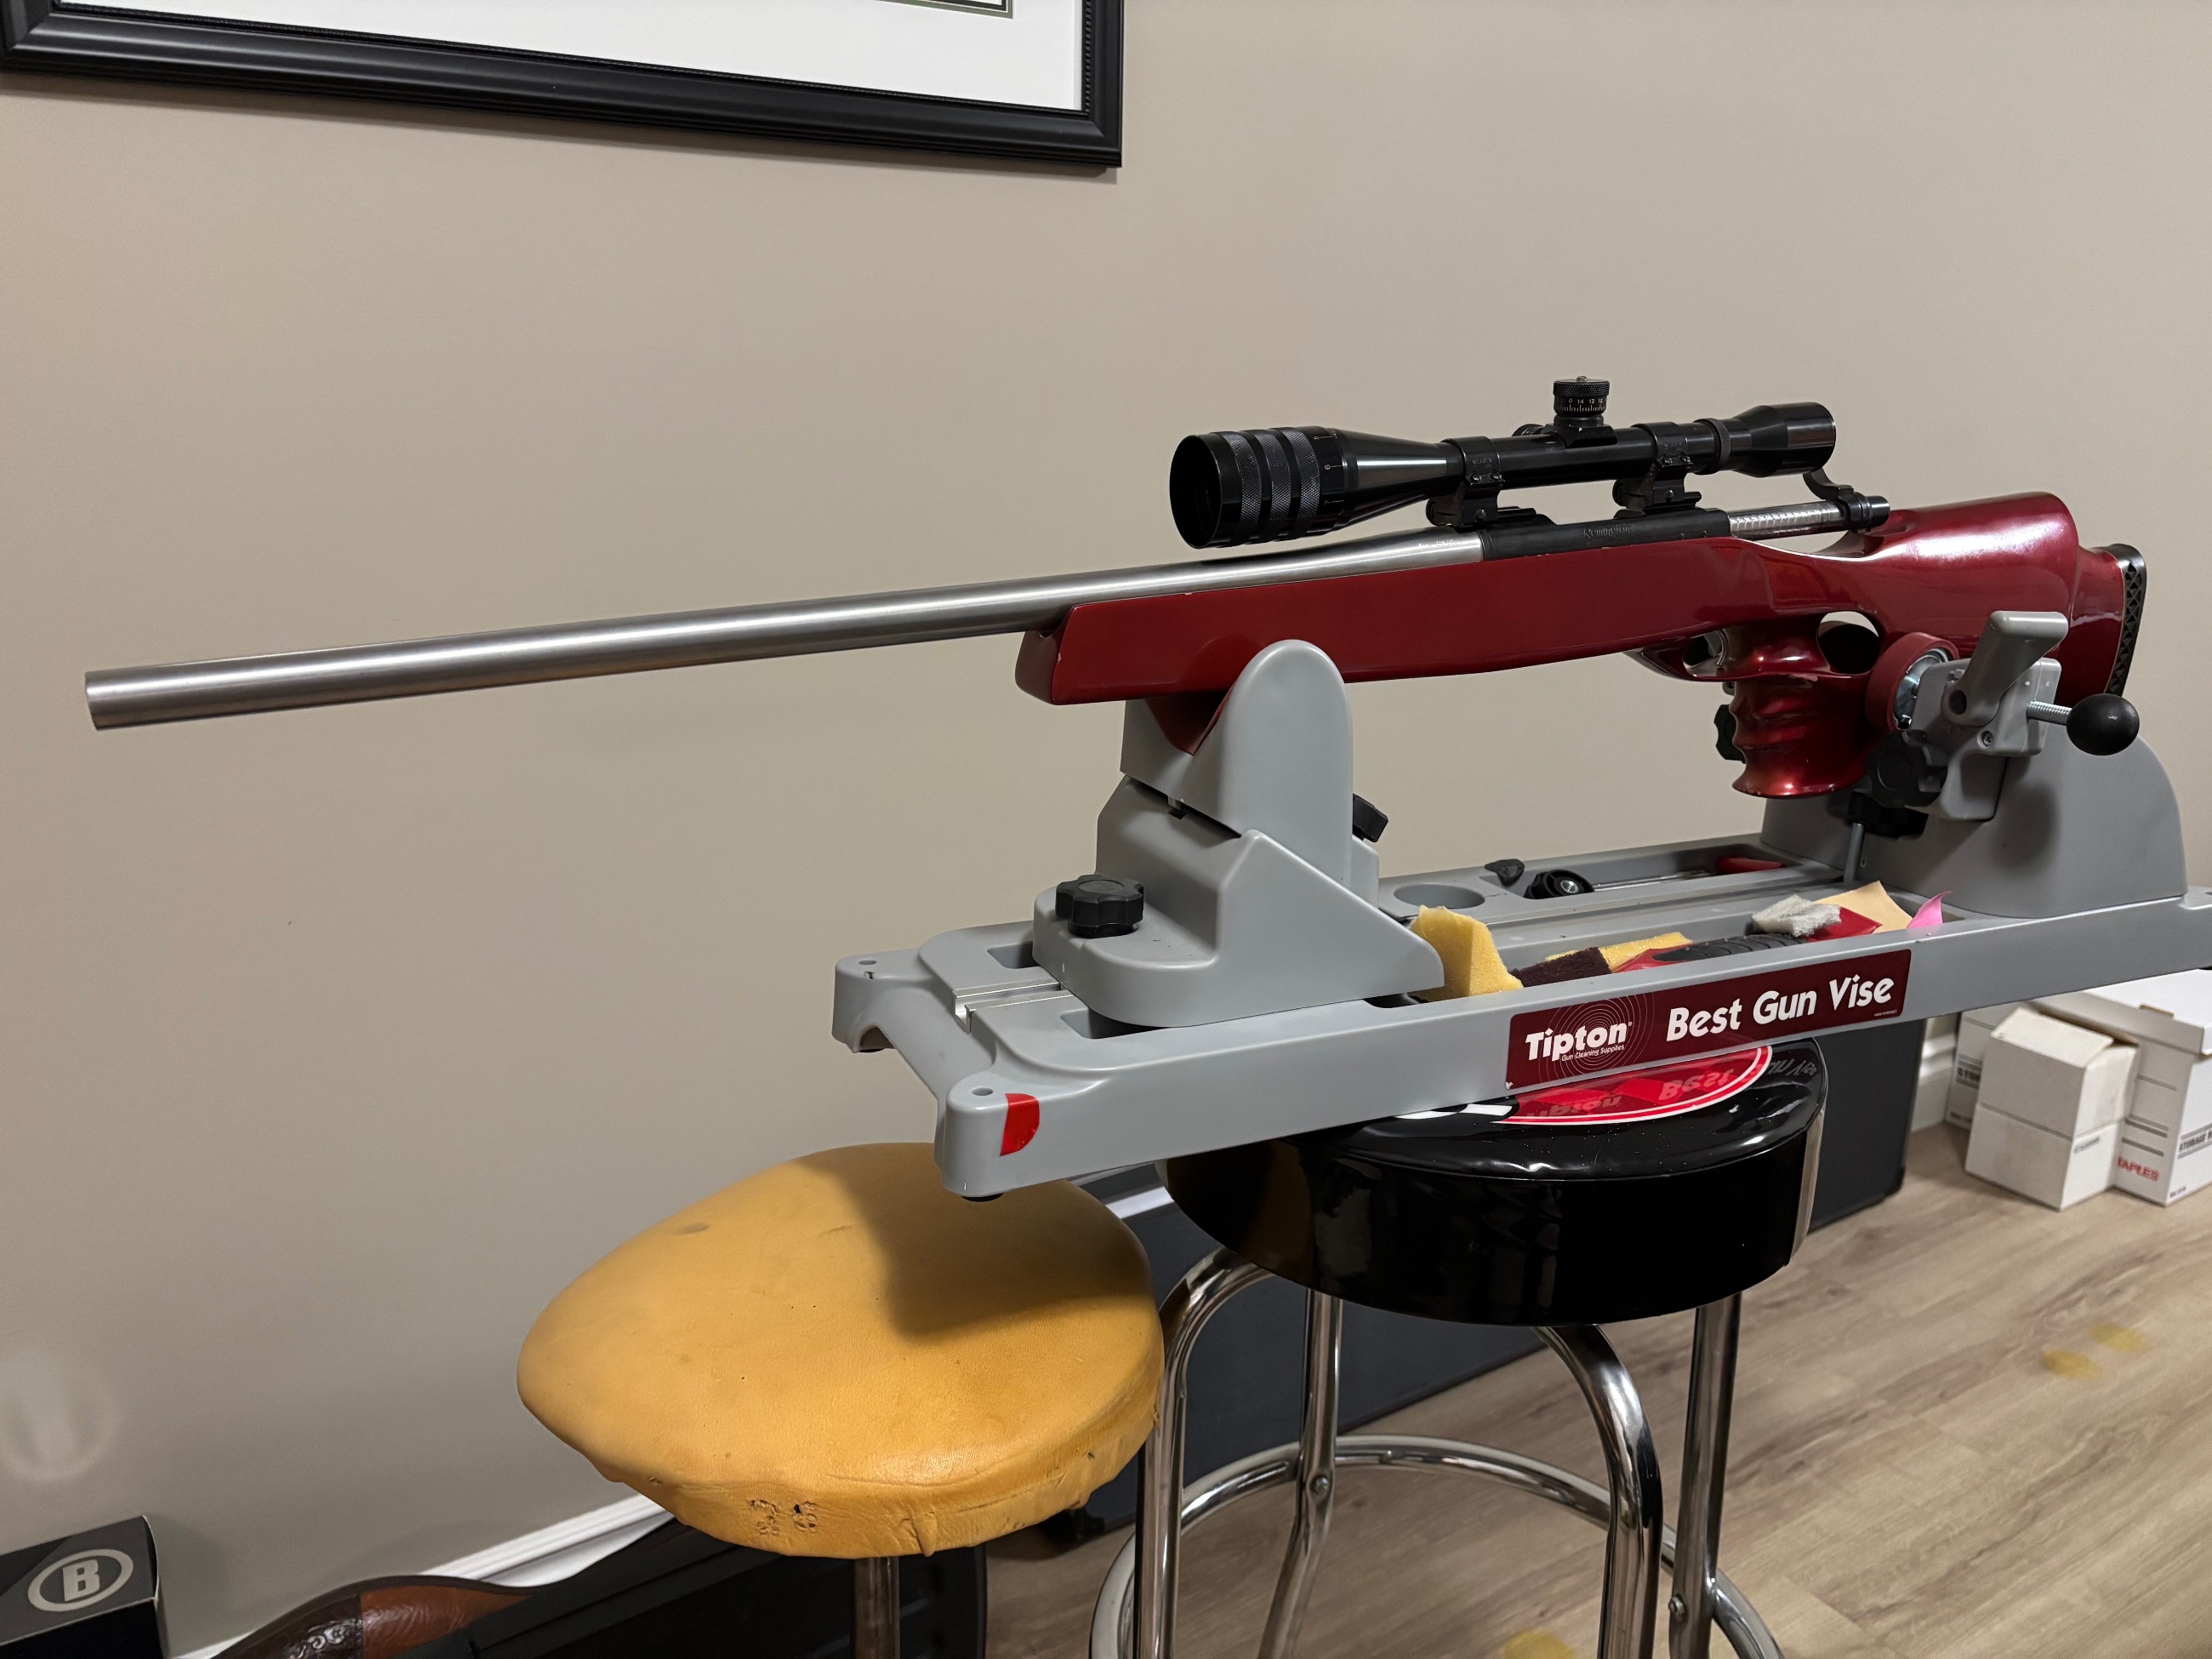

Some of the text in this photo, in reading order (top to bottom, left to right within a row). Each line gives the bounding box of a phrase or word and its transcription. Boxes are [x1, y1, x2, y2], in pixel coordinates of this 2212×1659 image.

[1666, 973, 1895, 1042] Best Gun Vise
[1525, 1023, 1628, 1062] Tipton
[1575, 1048, 1599, 1059] Cleaning
[1600, 1044, 1625, 1055] Supplies
[2117, 1155, 2160, 1182] TAPLES
[62, 1559, 100, 1602] B
